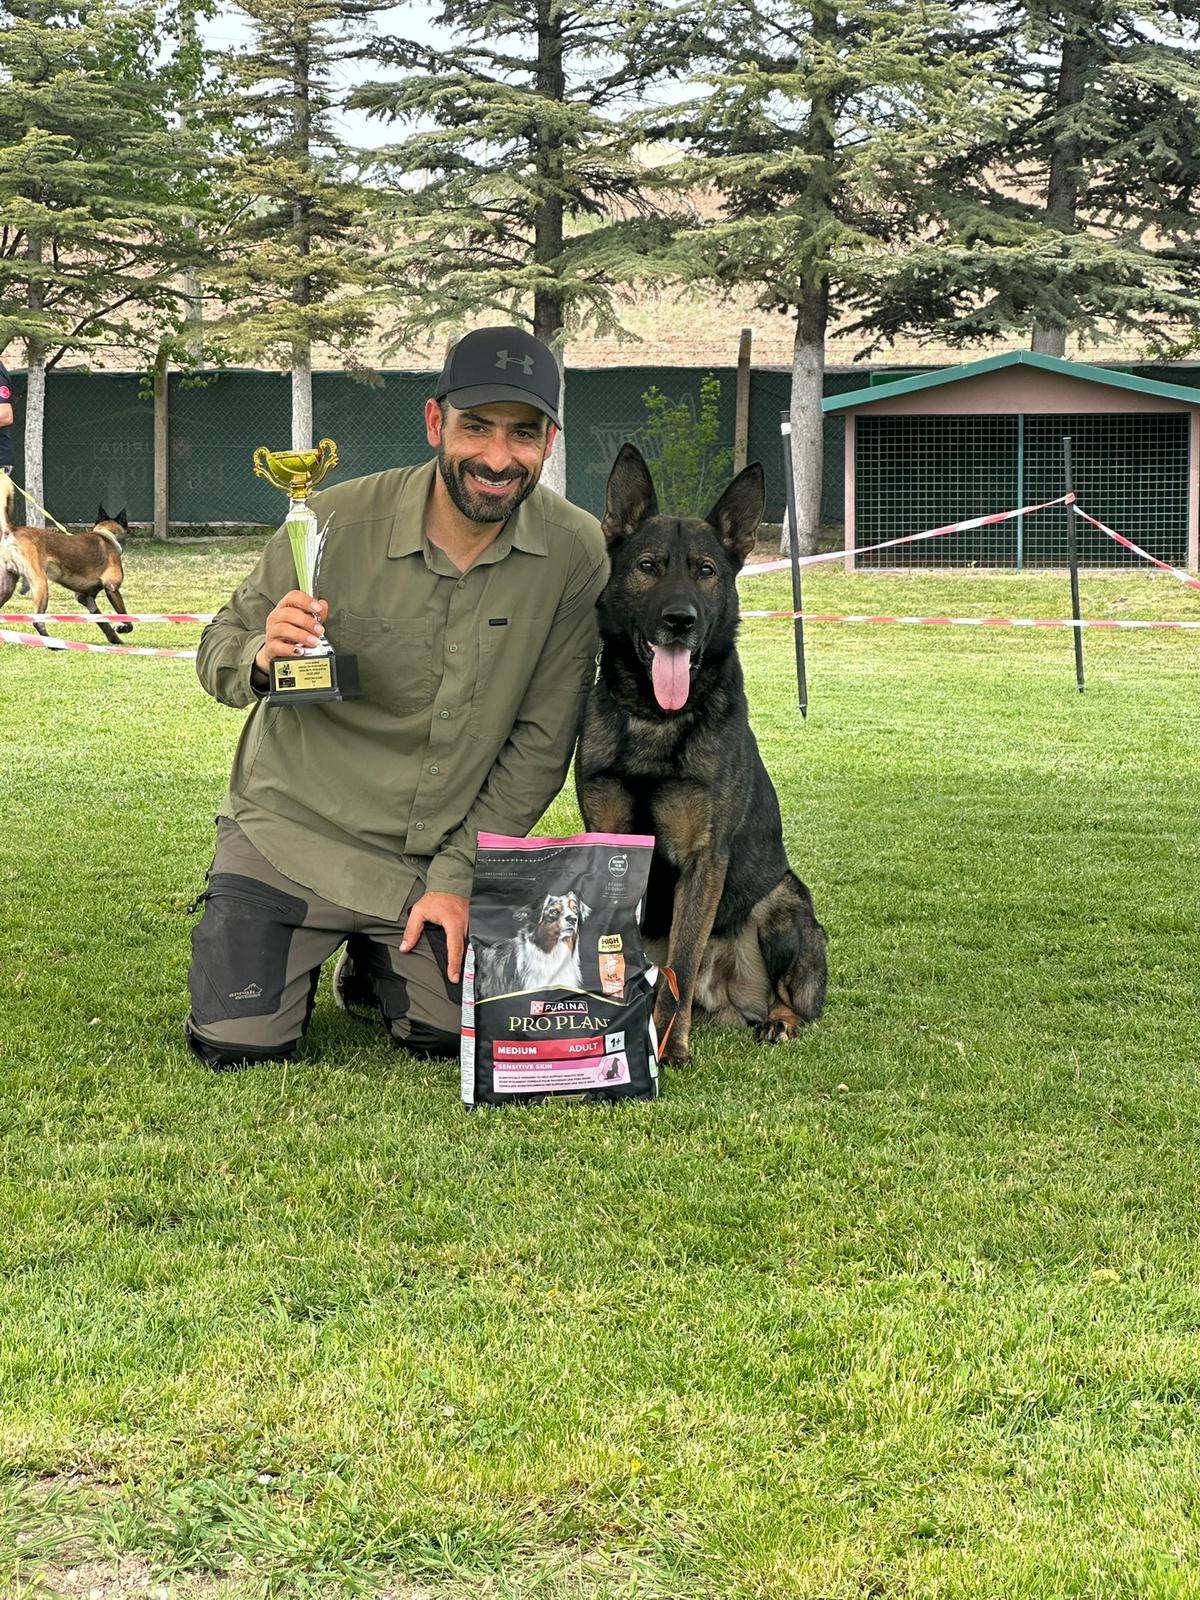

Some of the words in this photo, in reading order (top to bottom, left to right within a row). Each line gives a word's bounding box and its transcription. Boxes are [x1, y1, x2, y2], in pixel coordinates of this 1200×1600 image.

[544, 1002, 585, 1012] PURINA
[508, 1016, 552, 1032] PRO
[555, 1015, 608, 1031] PLAN
[497, 1046, 537, 1055] MEDIUM
[568, 1042, 598, 1053] ADULT
[610, 1038, 621, 1048] 1+
